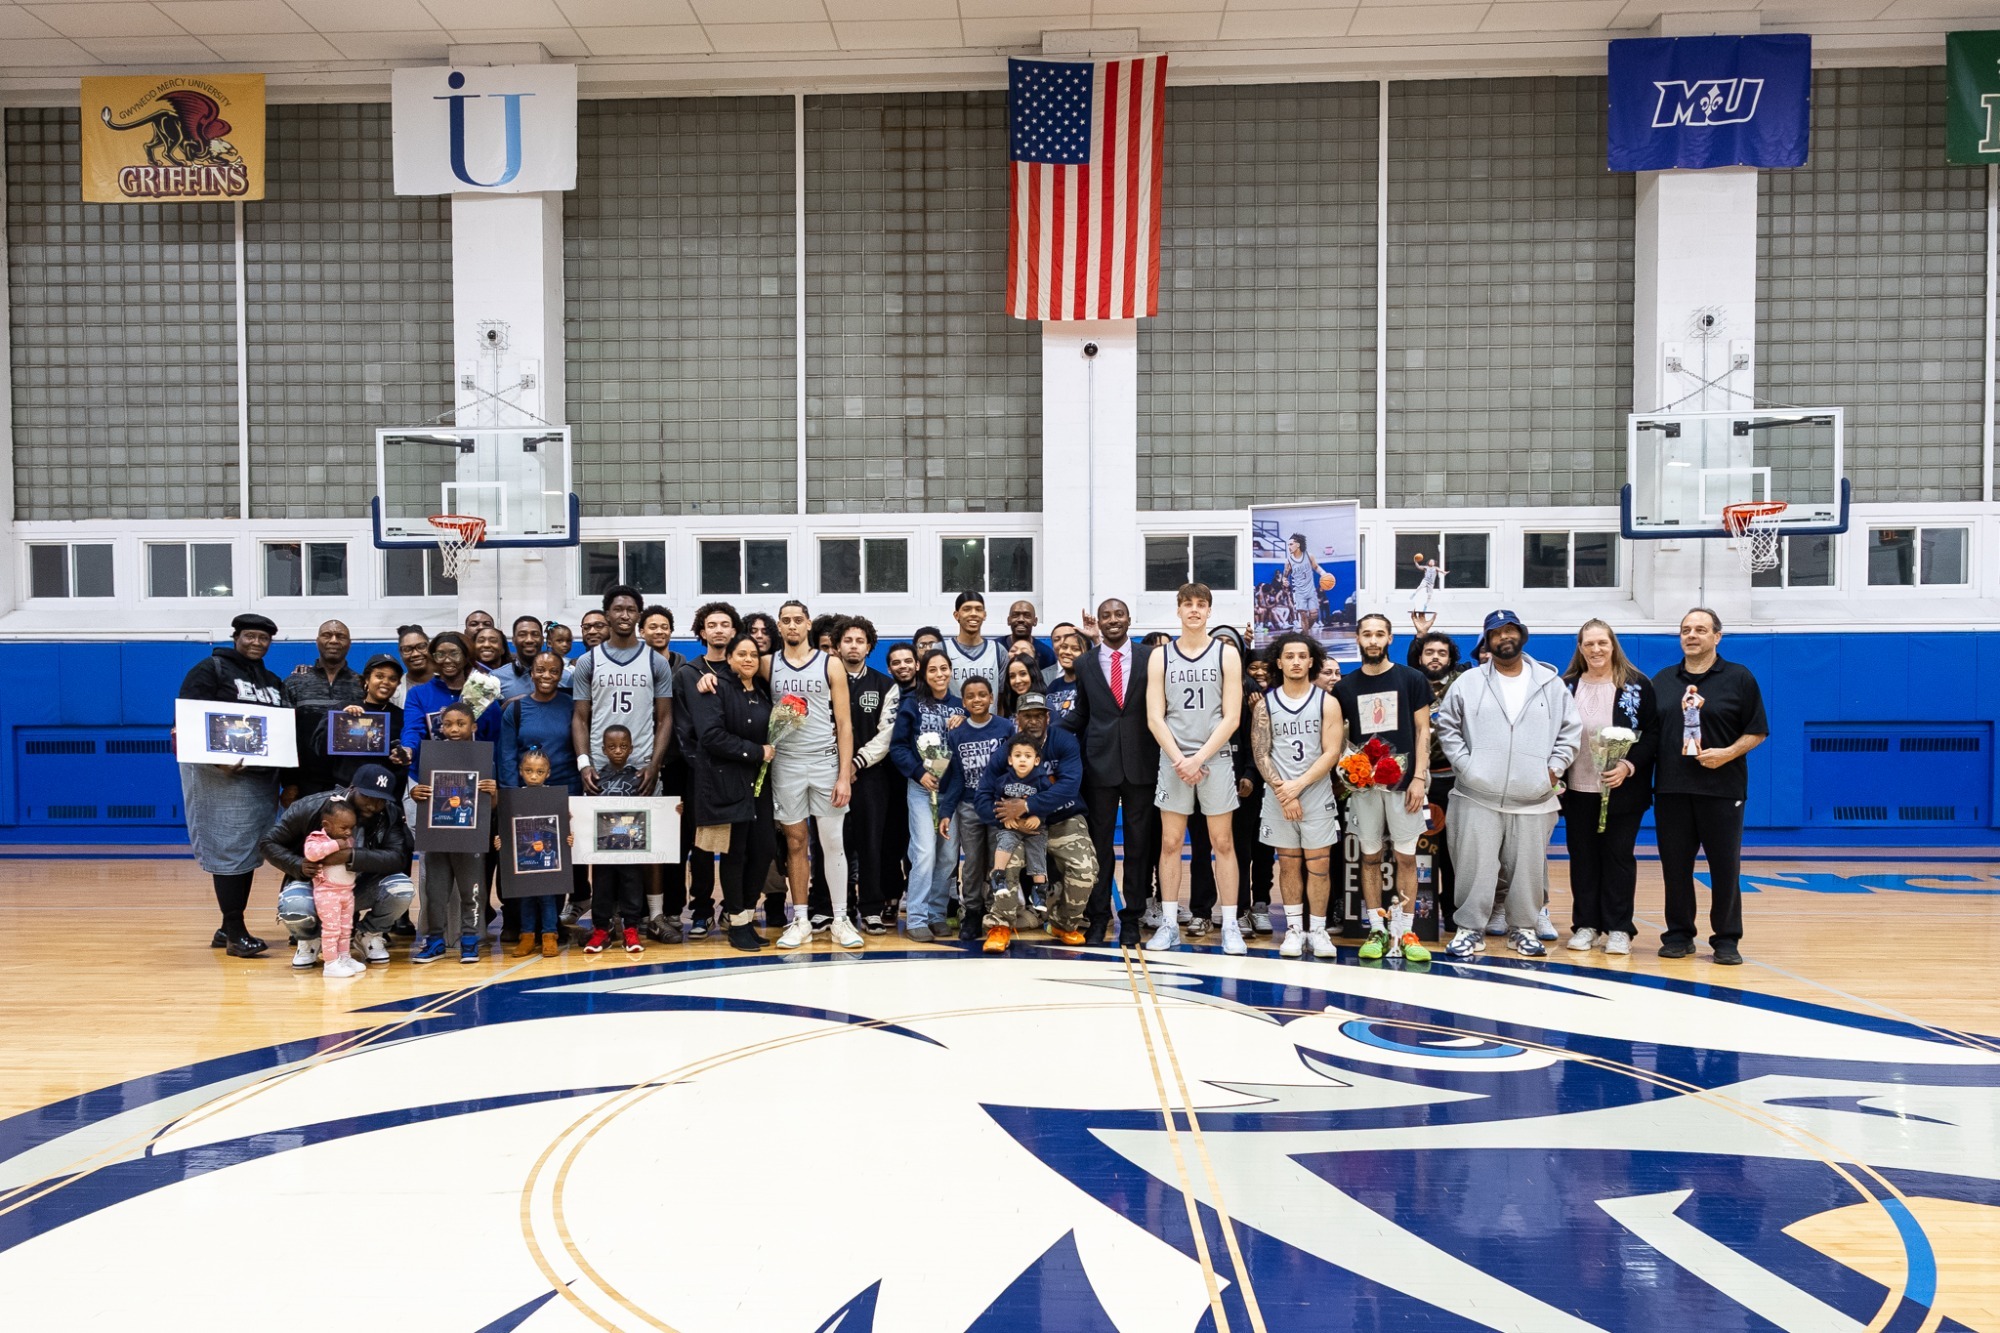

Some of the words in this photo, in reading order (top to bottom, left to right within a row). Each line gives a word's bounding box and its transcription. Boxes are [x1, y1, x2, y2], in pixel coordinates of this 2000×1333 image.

[119, 89, 157, 120] GWYNEDD
[157, 78, 187, 96] MERCY
[188, 78, 232, 108] UNIVERSITY
[118, 165, 249, 197] GRIFFINS
[598, 673, 647, 688] EAGLES
[774, 679, 822, 693] EAGLES
[1170, 668, 1217, 684] EAGLES
[612, 691, 633, 713] 15
[1183, 686, 1204, 710] 21
[1273, 719, 1320, 736] EAGLES
[1291, 739, 1305, 762] 3
[376, 774, 388, 788] NY
[1380, 861, 1394, 892] 3
